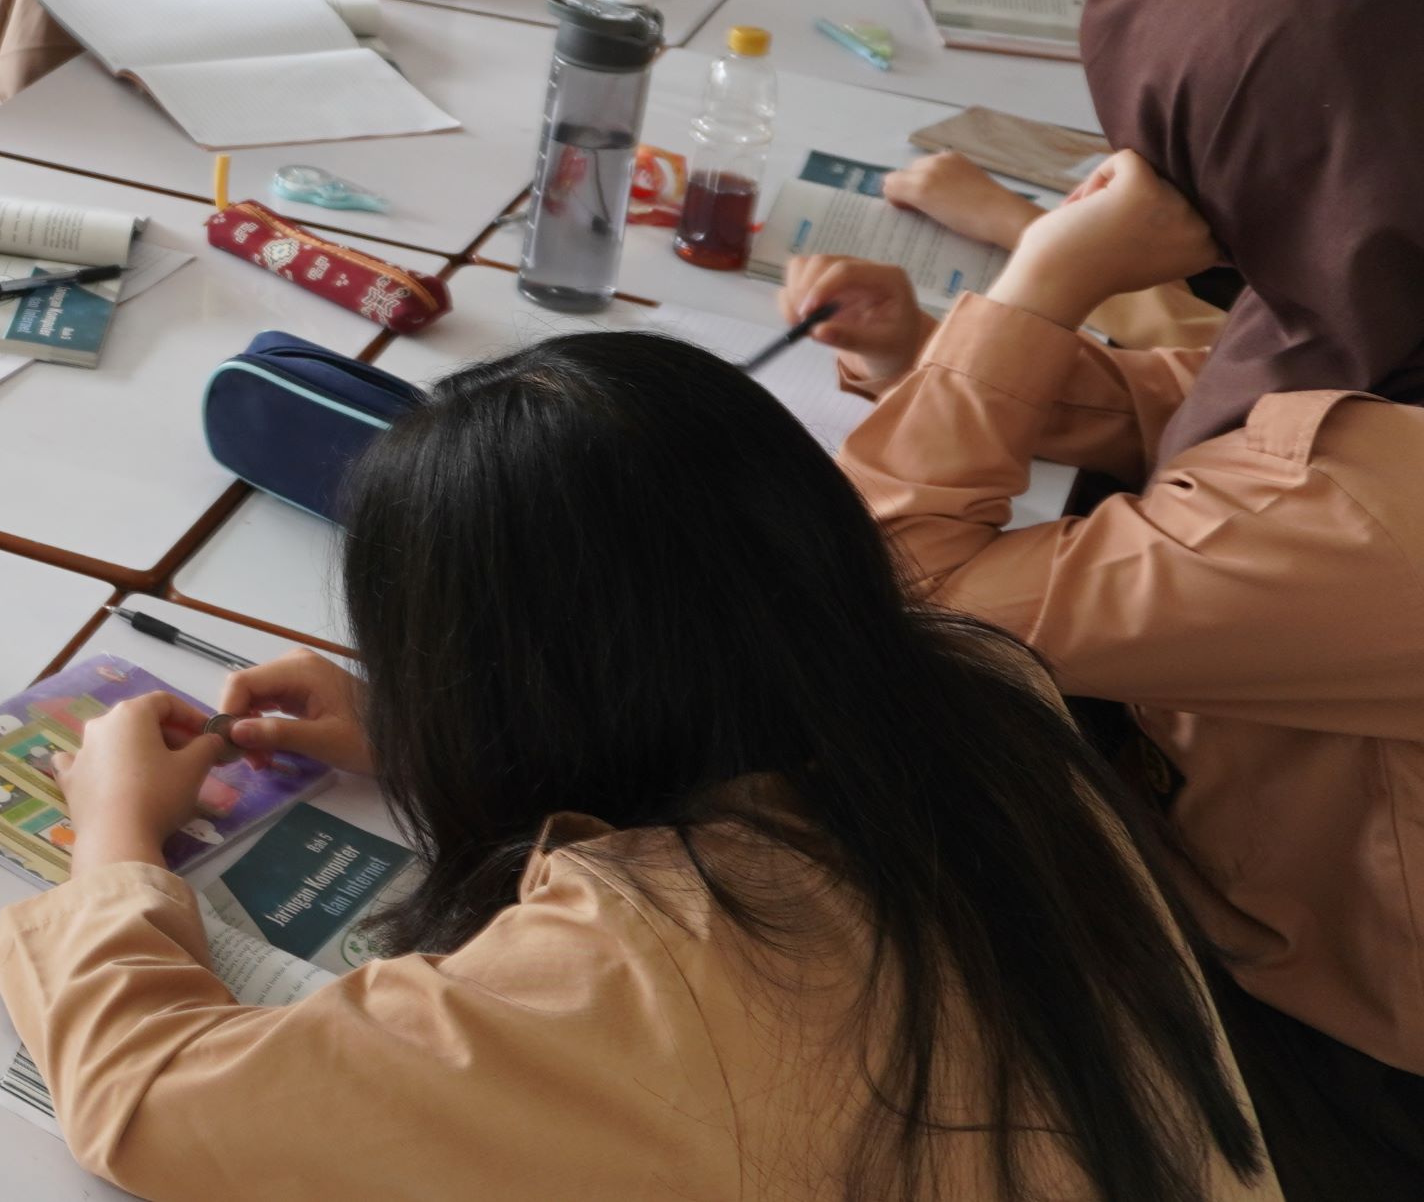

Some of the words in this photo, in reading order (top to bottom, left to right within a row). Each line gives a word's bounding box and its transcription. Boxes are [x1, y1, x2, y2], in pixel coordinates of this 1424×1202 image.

[306, 837, 329, 855] Bab
[321, 831, 335, 843] 5
[264, 884, 318, 928] Jaringan
[304, 844, 361, 891] Komputer
[319, 890, 352, 918] dan
[343, 855, 392, 899] Internet
